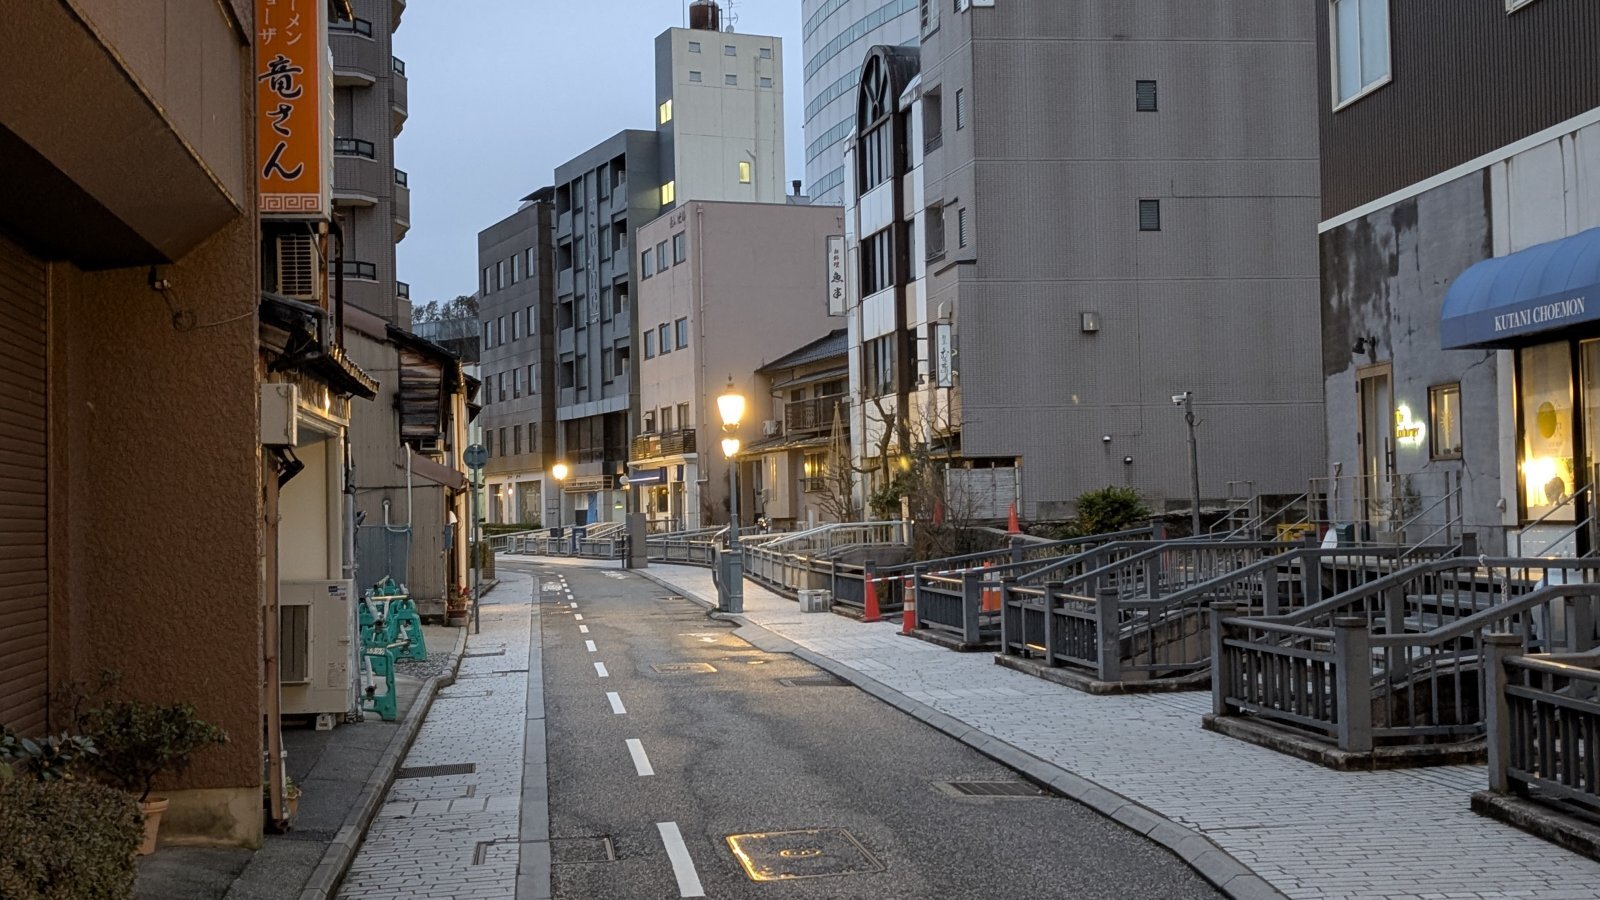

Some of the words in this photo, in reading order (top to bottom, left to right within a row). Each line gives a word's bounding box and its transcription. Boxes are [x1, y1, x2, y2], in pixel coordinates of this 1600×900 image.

[257, 54, 304, 181] 竜さん
[1495, 309, 1531, 331] KUTANI
[1533, 297, 1584, 322] CHOEMON
